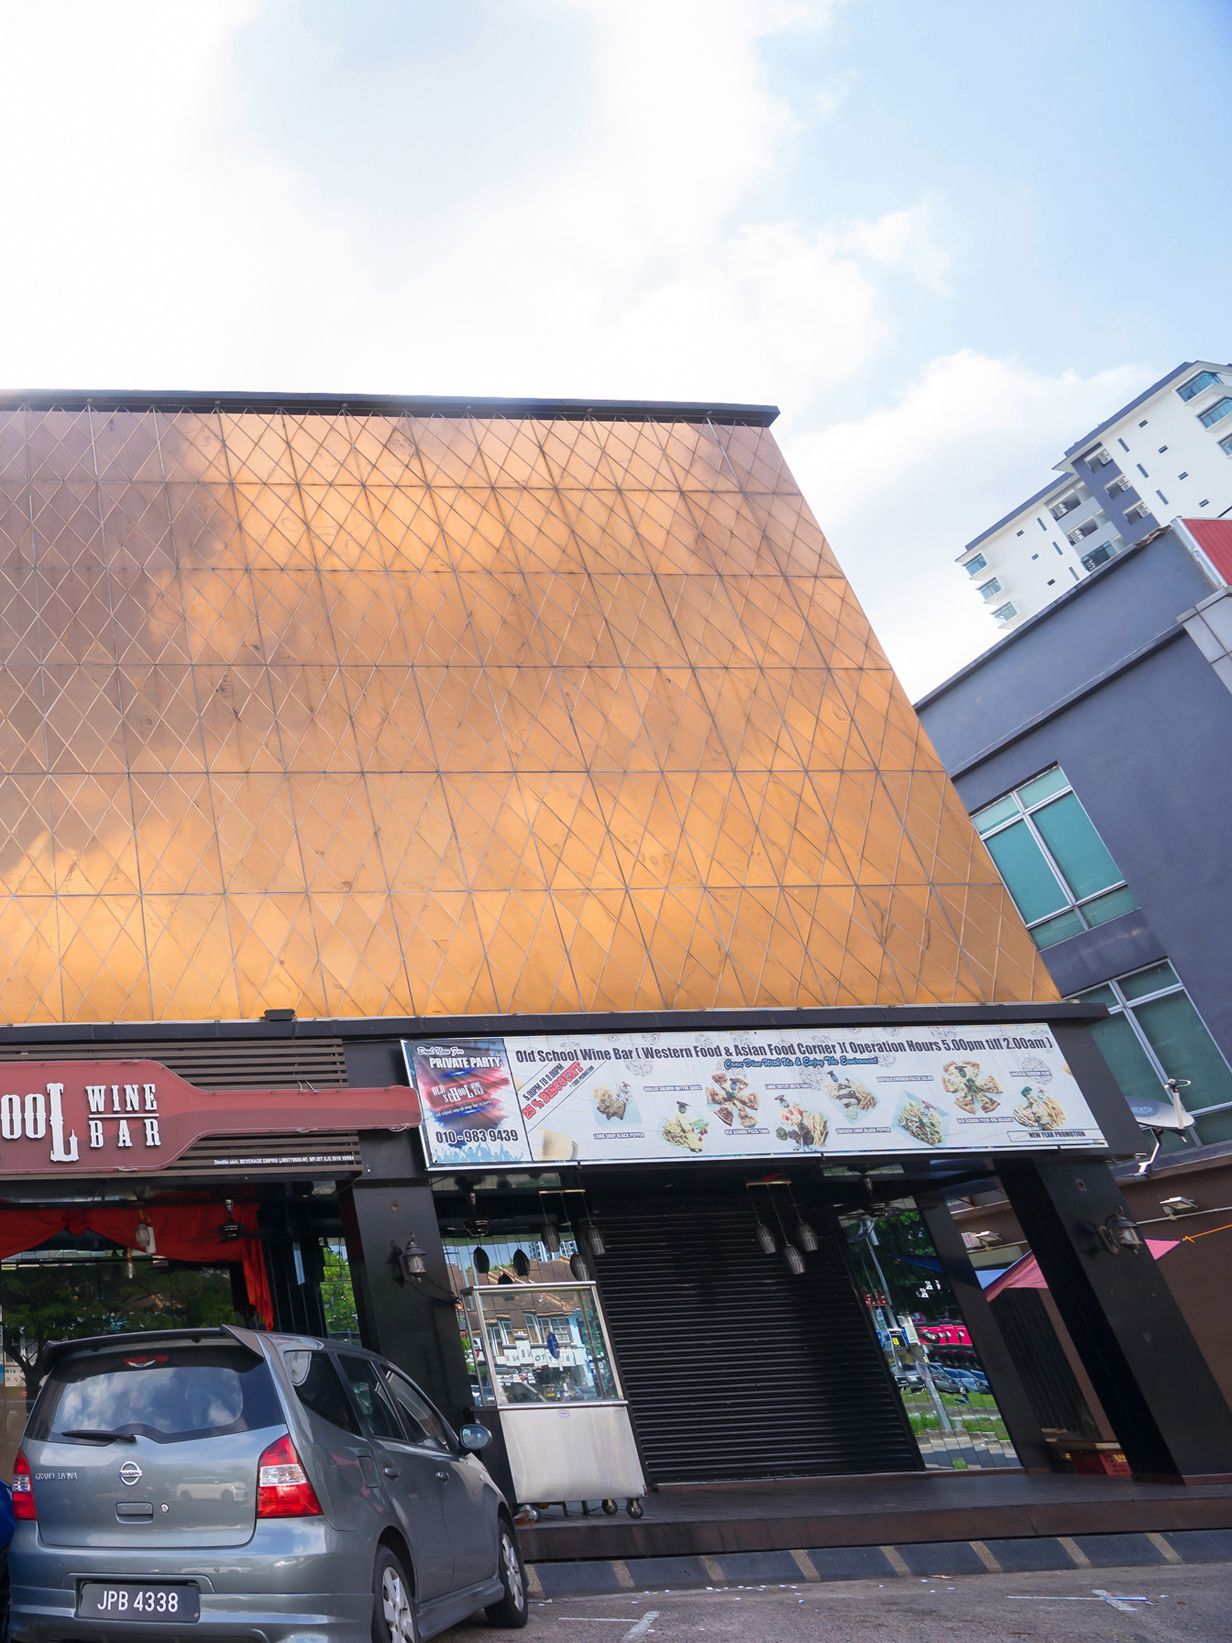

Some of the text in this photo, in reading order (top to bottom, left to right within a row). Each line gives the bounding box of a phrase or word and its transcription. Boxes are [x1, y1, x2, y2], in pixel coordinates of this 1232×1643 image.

[515, 1050, 536, 1063] Old
[537, 1049, 579, 1062] School
[579, 1048, 612, 1061] Wine
[612, 1047, 633, 1060] Bar
[641, 1046, 693, 1059] Western
[693, 1045, 723, 1058] Food
[724, 1046, 733, 1057] &
[733, 1044, 766, 1056] Asian
[767, 1043, 796, 1056] Food
[796, 1042, 837, 1055] Corner
[850, 1040, 904, 1055] Operation
[905, 1039, 941, 1053] Hours
[941, 1038, 986, 1053] 5.00pm
[986, 1038, 1003, 1050] till
[1003, 1037, 1046, 1050] 2.00am
[429, 1056, 502, 1069] PRIVATE PARTY
[85, 1083, 158, 1113] WINE
[89, 1118, 162, 1149] BAR
[435, 1130, 455, 1143] 010
[464, 1130, 487, 1143] 983
[489, 1129, 519, 1142] 9439
[97, 1590, 179, 1613] JPB 4338
